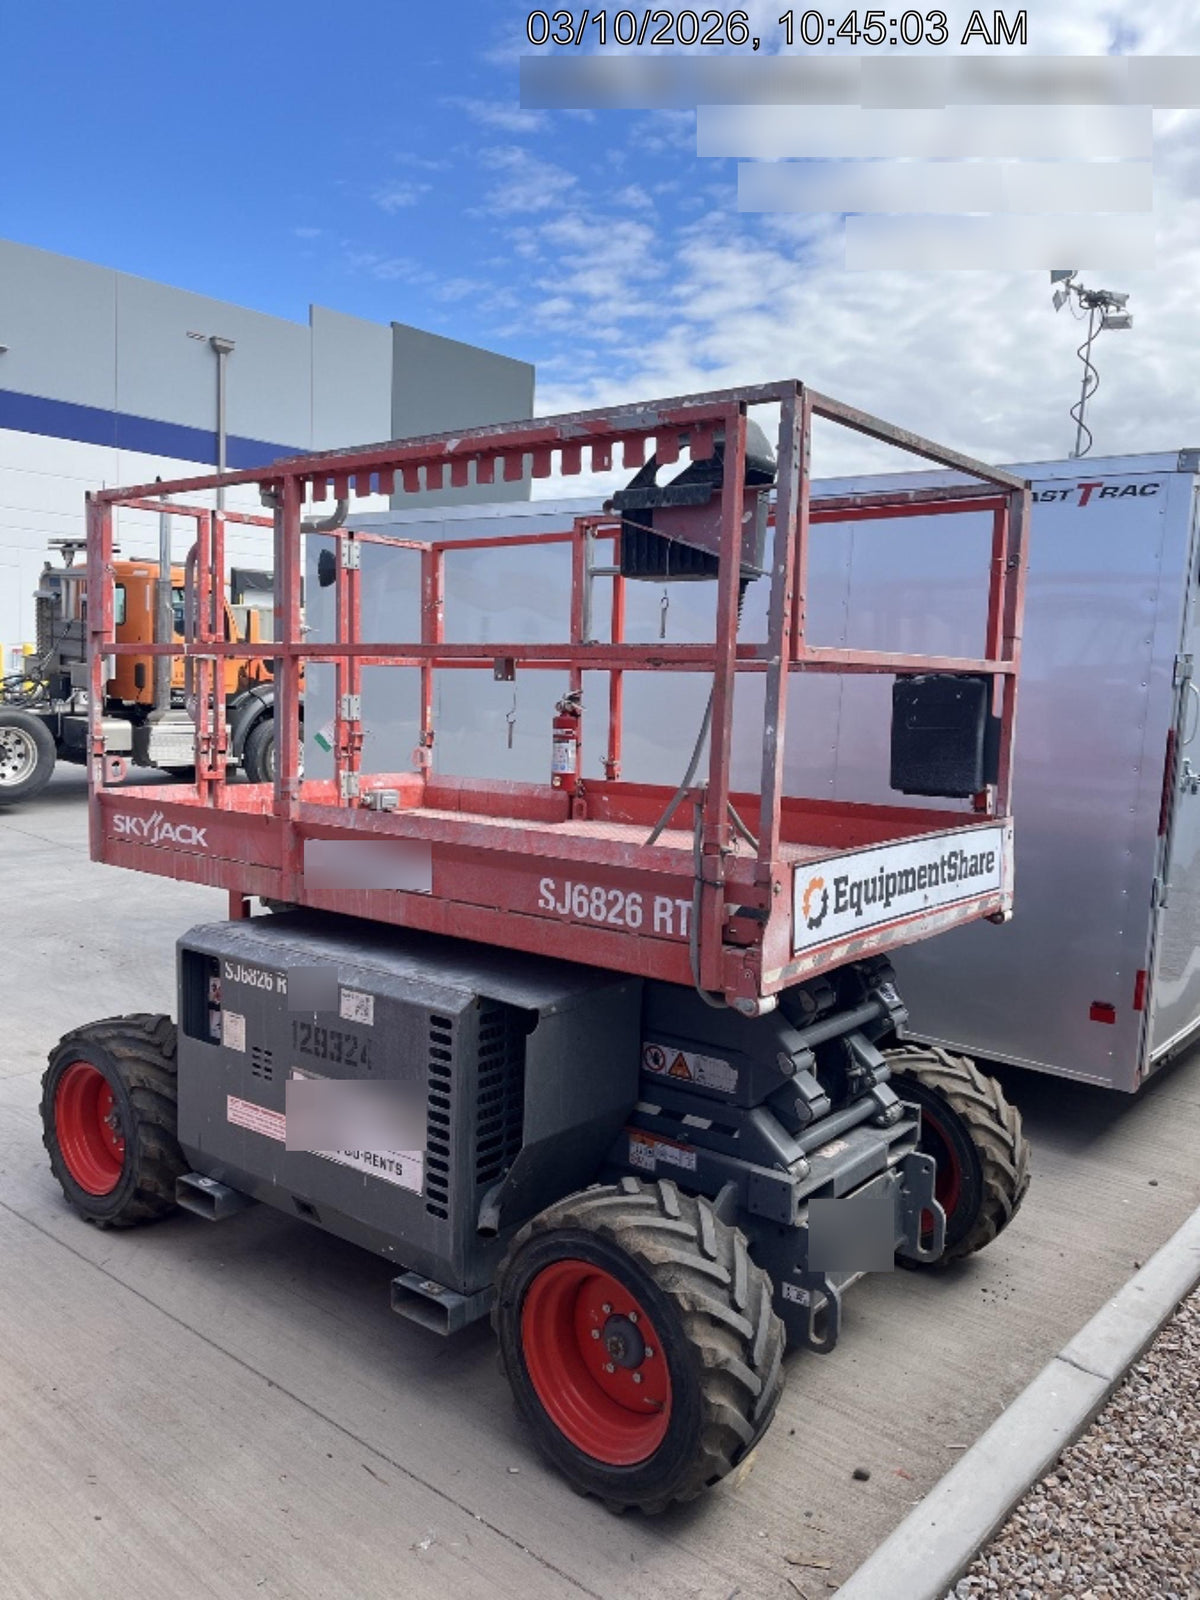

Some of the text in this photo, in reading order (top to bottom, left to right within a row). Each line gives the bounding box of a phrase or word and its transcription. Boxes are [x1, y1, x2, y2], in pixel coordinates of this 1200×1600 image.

[113, 810, 208, 847] SKYJACK
[538, 877, 692, 936] SJ6826 RT
[833, 850, 995, 917] EquipmentShare
